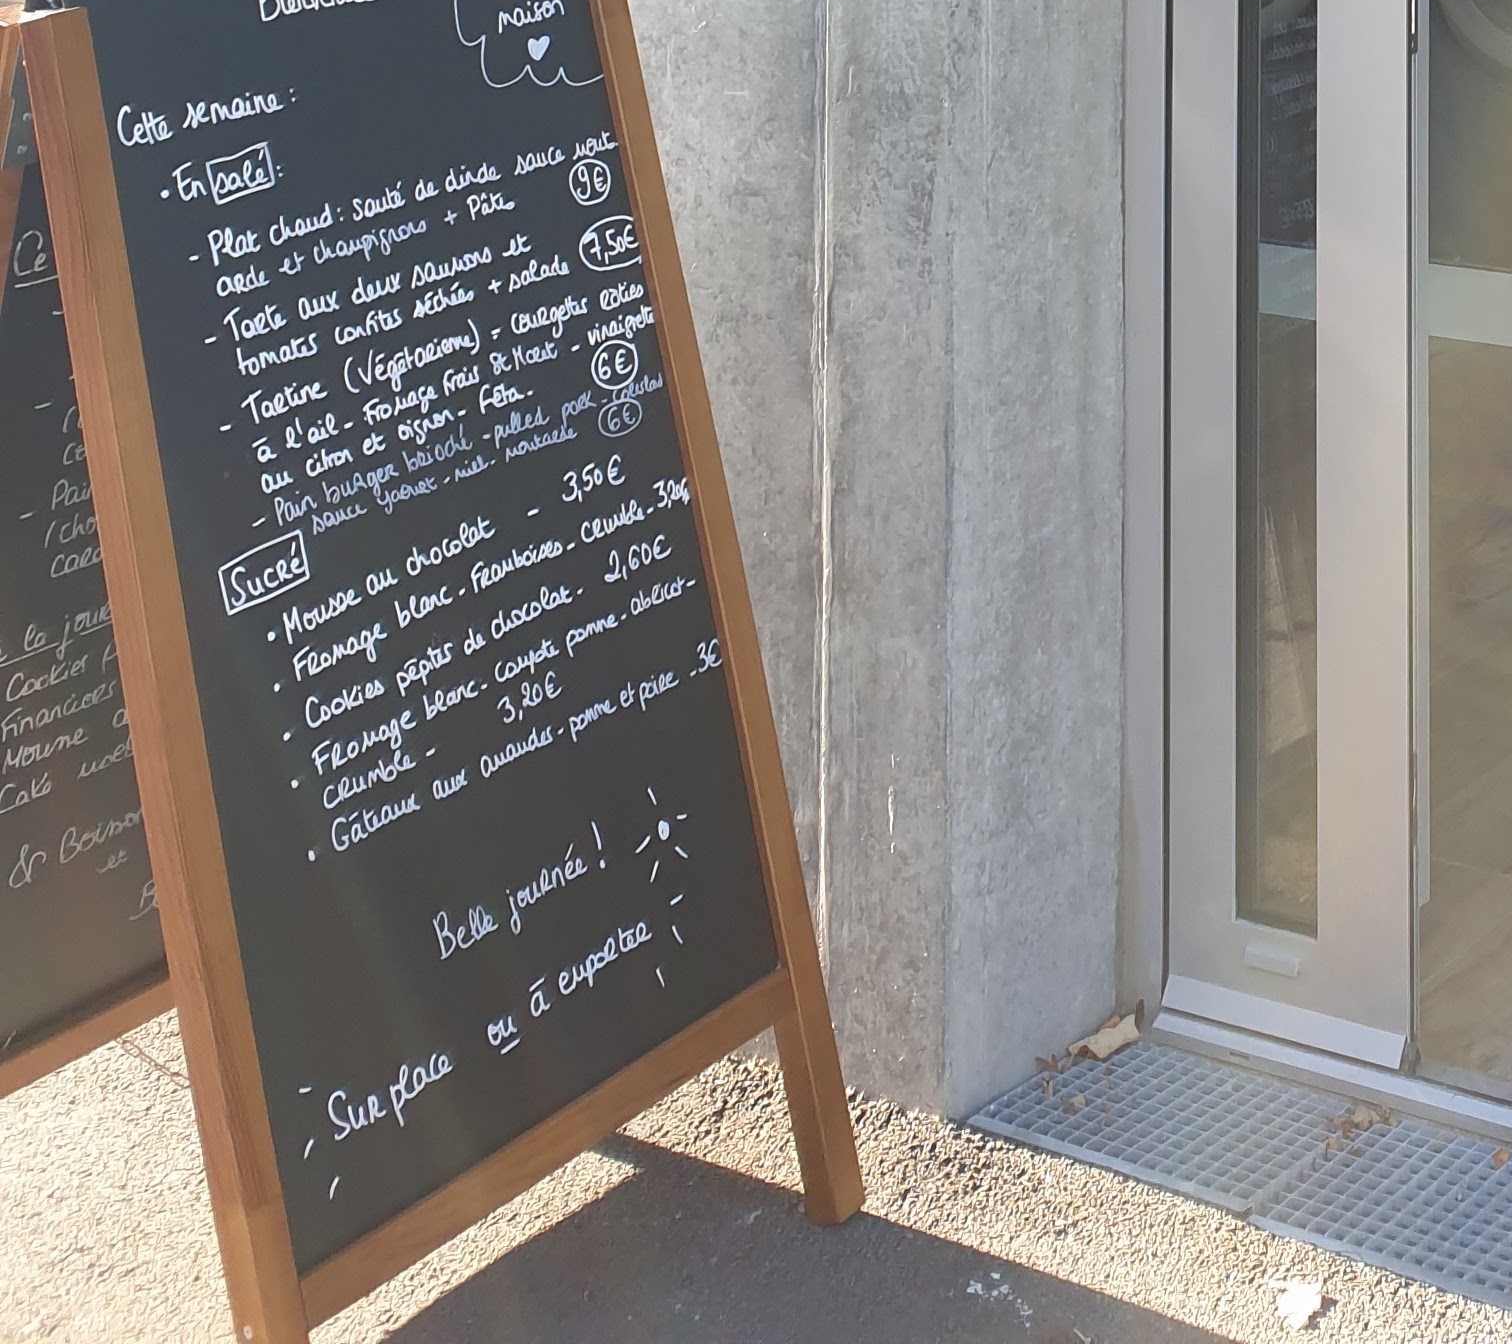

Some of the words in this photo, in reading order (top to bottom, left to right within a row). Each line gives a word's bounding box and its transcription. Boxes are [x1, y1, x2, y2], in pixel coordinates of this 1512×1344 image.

[116, 104, 174, 148] Cette
[171, 160, 208, 203] En
[207, 229, 261, 267] Plat
[352, 179, 406, 222] sauté
[414, 175, 440, 201] de
[445, 162, 502, 193] dinde
[514, 146, 566, 176] sauce
[223, 303, 288, 342] Tarte
[298, 290, 341, 321] aux
[351, 270, 401, 307] deux
[410, 247, 493, 290] saumons
[502, 233, 533, 258] et
[278, 252, 305, 275] et
[313, 217, 428, 262] champignons
[236, 332, 319, 377] tomates
[507, 255, 571, 294] salade
[241, 380, 328, 424] Tartine
[260, 470, 294, 494] au
[305, 447, 354, 478] citron
[362, 432, 386, 456] et
[273, 490, 318, 527] Pain
[493, 405, 551, 450] pulled
[311, 502, 368, 536] sauce
[282, 586, 363, 646] Mousse
[366, 569, 399, 597] au
[405, 515, 497, 577] chocolat
[5, 653, 89, 703] Cookies
[291, 622, 388, 683] Fromage
[395, 584, 453, 630] blanc
[303, 679, 386, 730] Cookies
[463, 628, 488, 657] de
[489, 583, 575, 641] chocolat
[310, 711, 418, 776] Fromage
[423, 682, 478, 722] blanc
[431, 772, 469, 802] aux
[568, 698, 618, 743] pomme
[618, 686, 636, 708] et
[321, 750, 417, 810] crumble
[431, 905, 499, 960] Belle
[326, 1089, 388, 1142] Sur
[390, 1051, 454, 1127] place
[486, 1012, 518, 1047] ou
[557, 920, 654, 996] emporter
